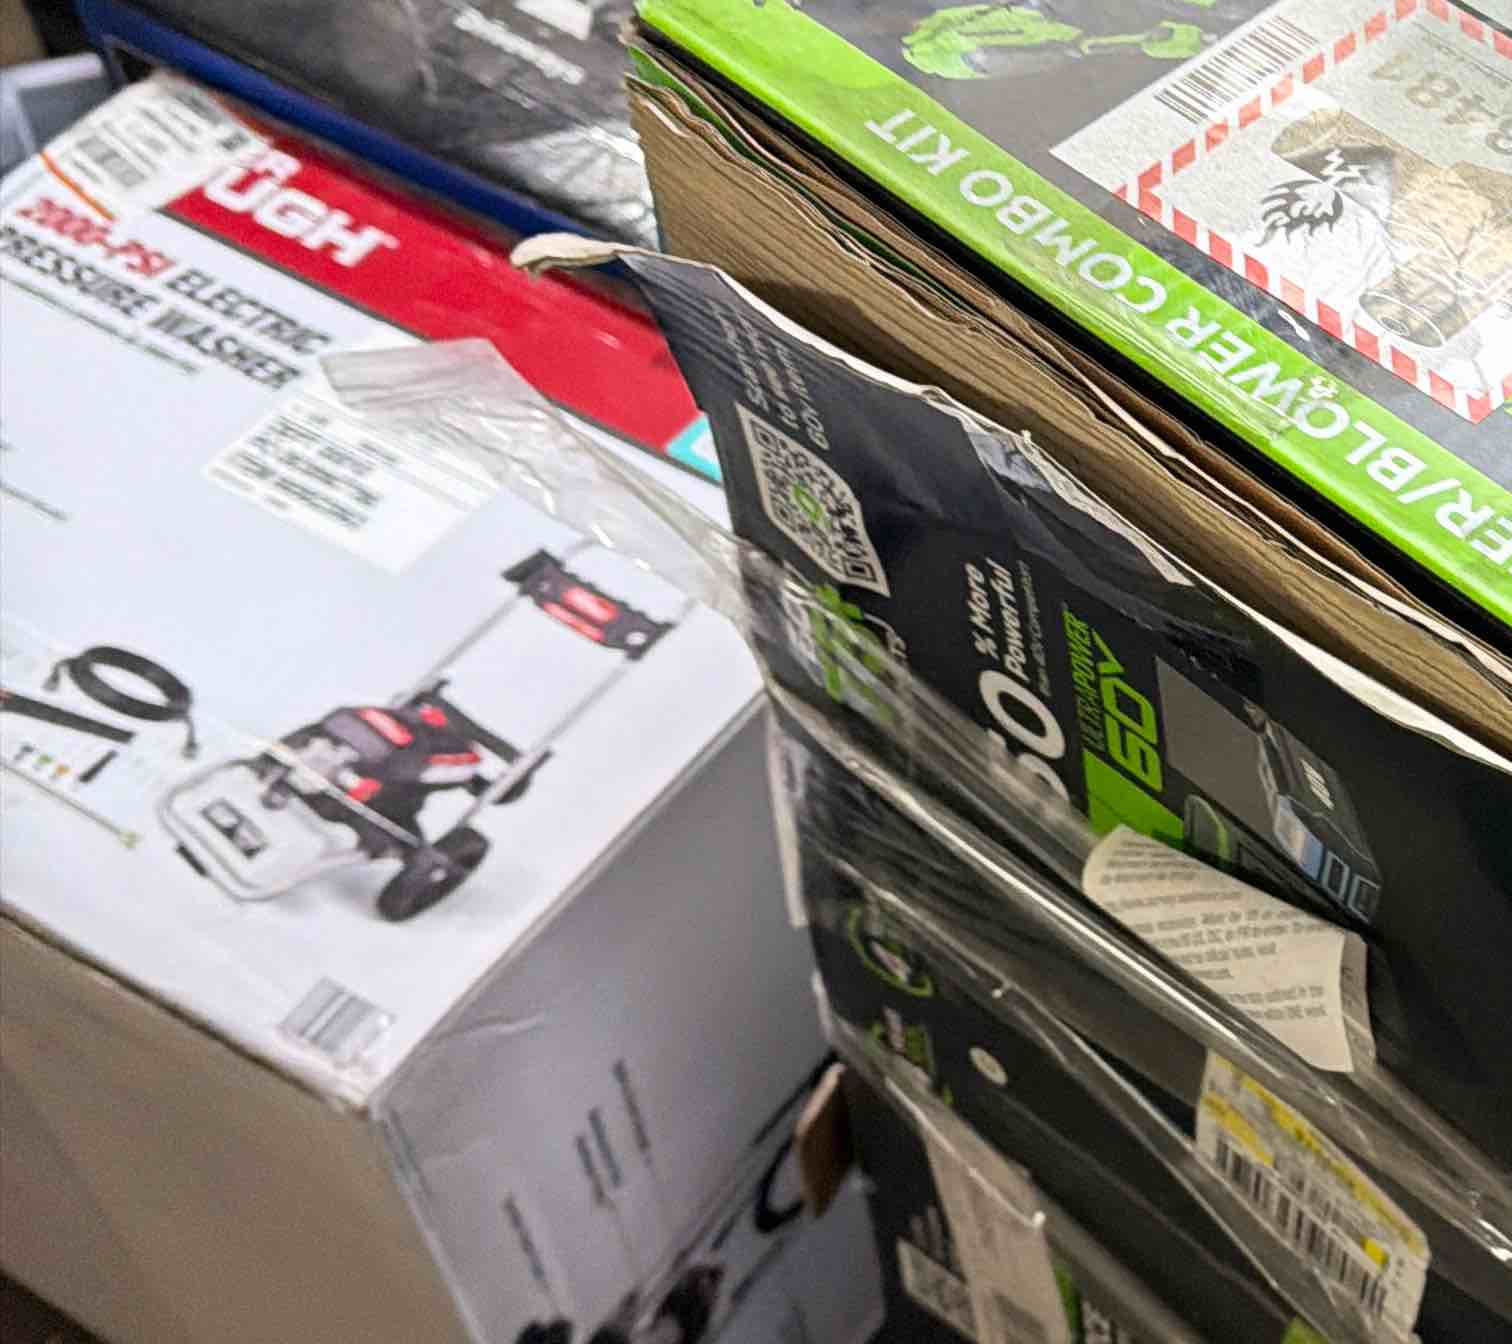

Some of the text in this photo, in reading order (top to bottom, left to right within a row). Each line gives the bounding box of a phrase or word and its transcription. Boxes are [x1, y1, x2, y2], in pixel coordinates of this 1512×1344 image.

[863, 106, 969, 177] KIT
[203, 162, 400, 269] UGH
[959, 169, 1167, 313] COMBO
[146, 306, 301, 391] WASHER
[165, 268, 333, 357] ELECTRIC
[962, 560, 995, 630] More
[984, 555, 1031, 680] Powerful
[1091, 627, 1164, 792] 60V
